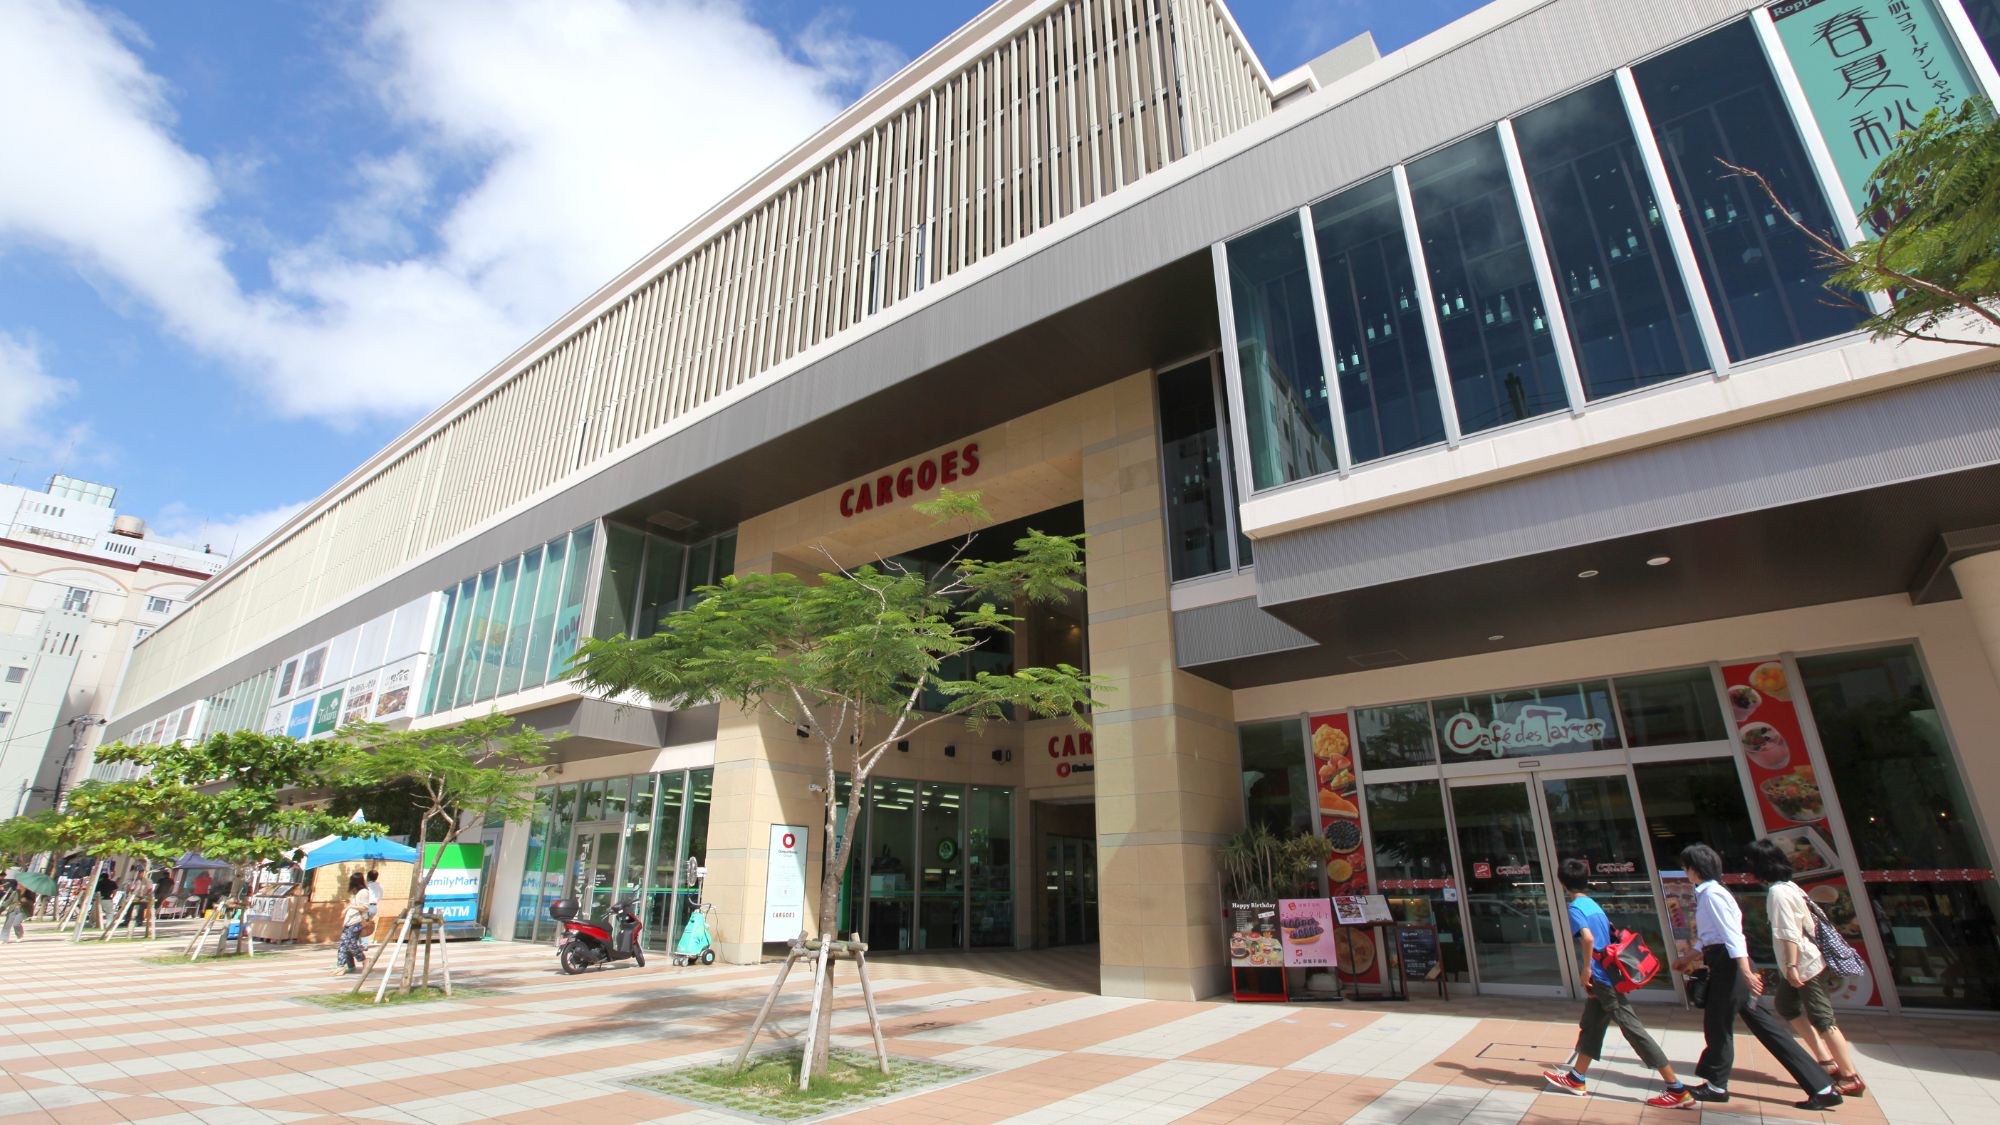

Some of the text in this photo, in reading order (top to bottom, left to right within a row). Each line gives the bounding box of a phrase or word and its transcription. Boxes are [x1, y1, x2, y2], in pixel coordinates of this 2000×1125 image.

[840, 443, 980, 518] CARGOES
[1449, 709, 1604, 754] Café des Tartes
[427, 877, 478, 888] amilyMart
